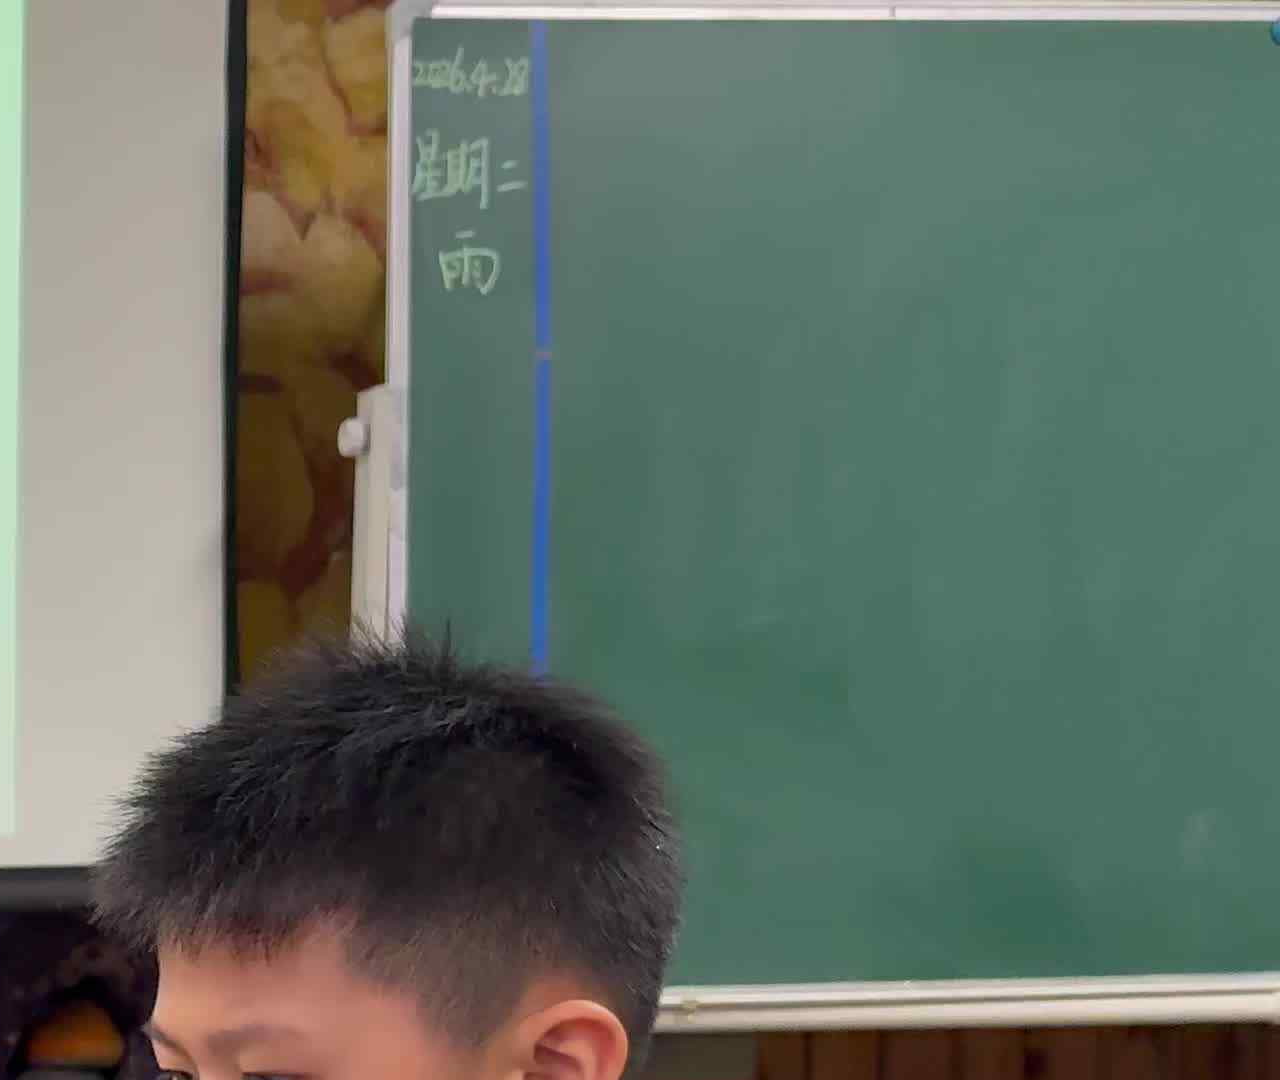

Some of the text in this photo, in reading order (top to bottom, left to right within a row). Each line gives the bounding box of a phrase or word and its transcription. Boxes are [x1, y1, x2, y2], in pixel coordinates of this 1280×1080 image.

[411, 128, 528, 210] 星期二
[438, 230, 501, 295] 雨
